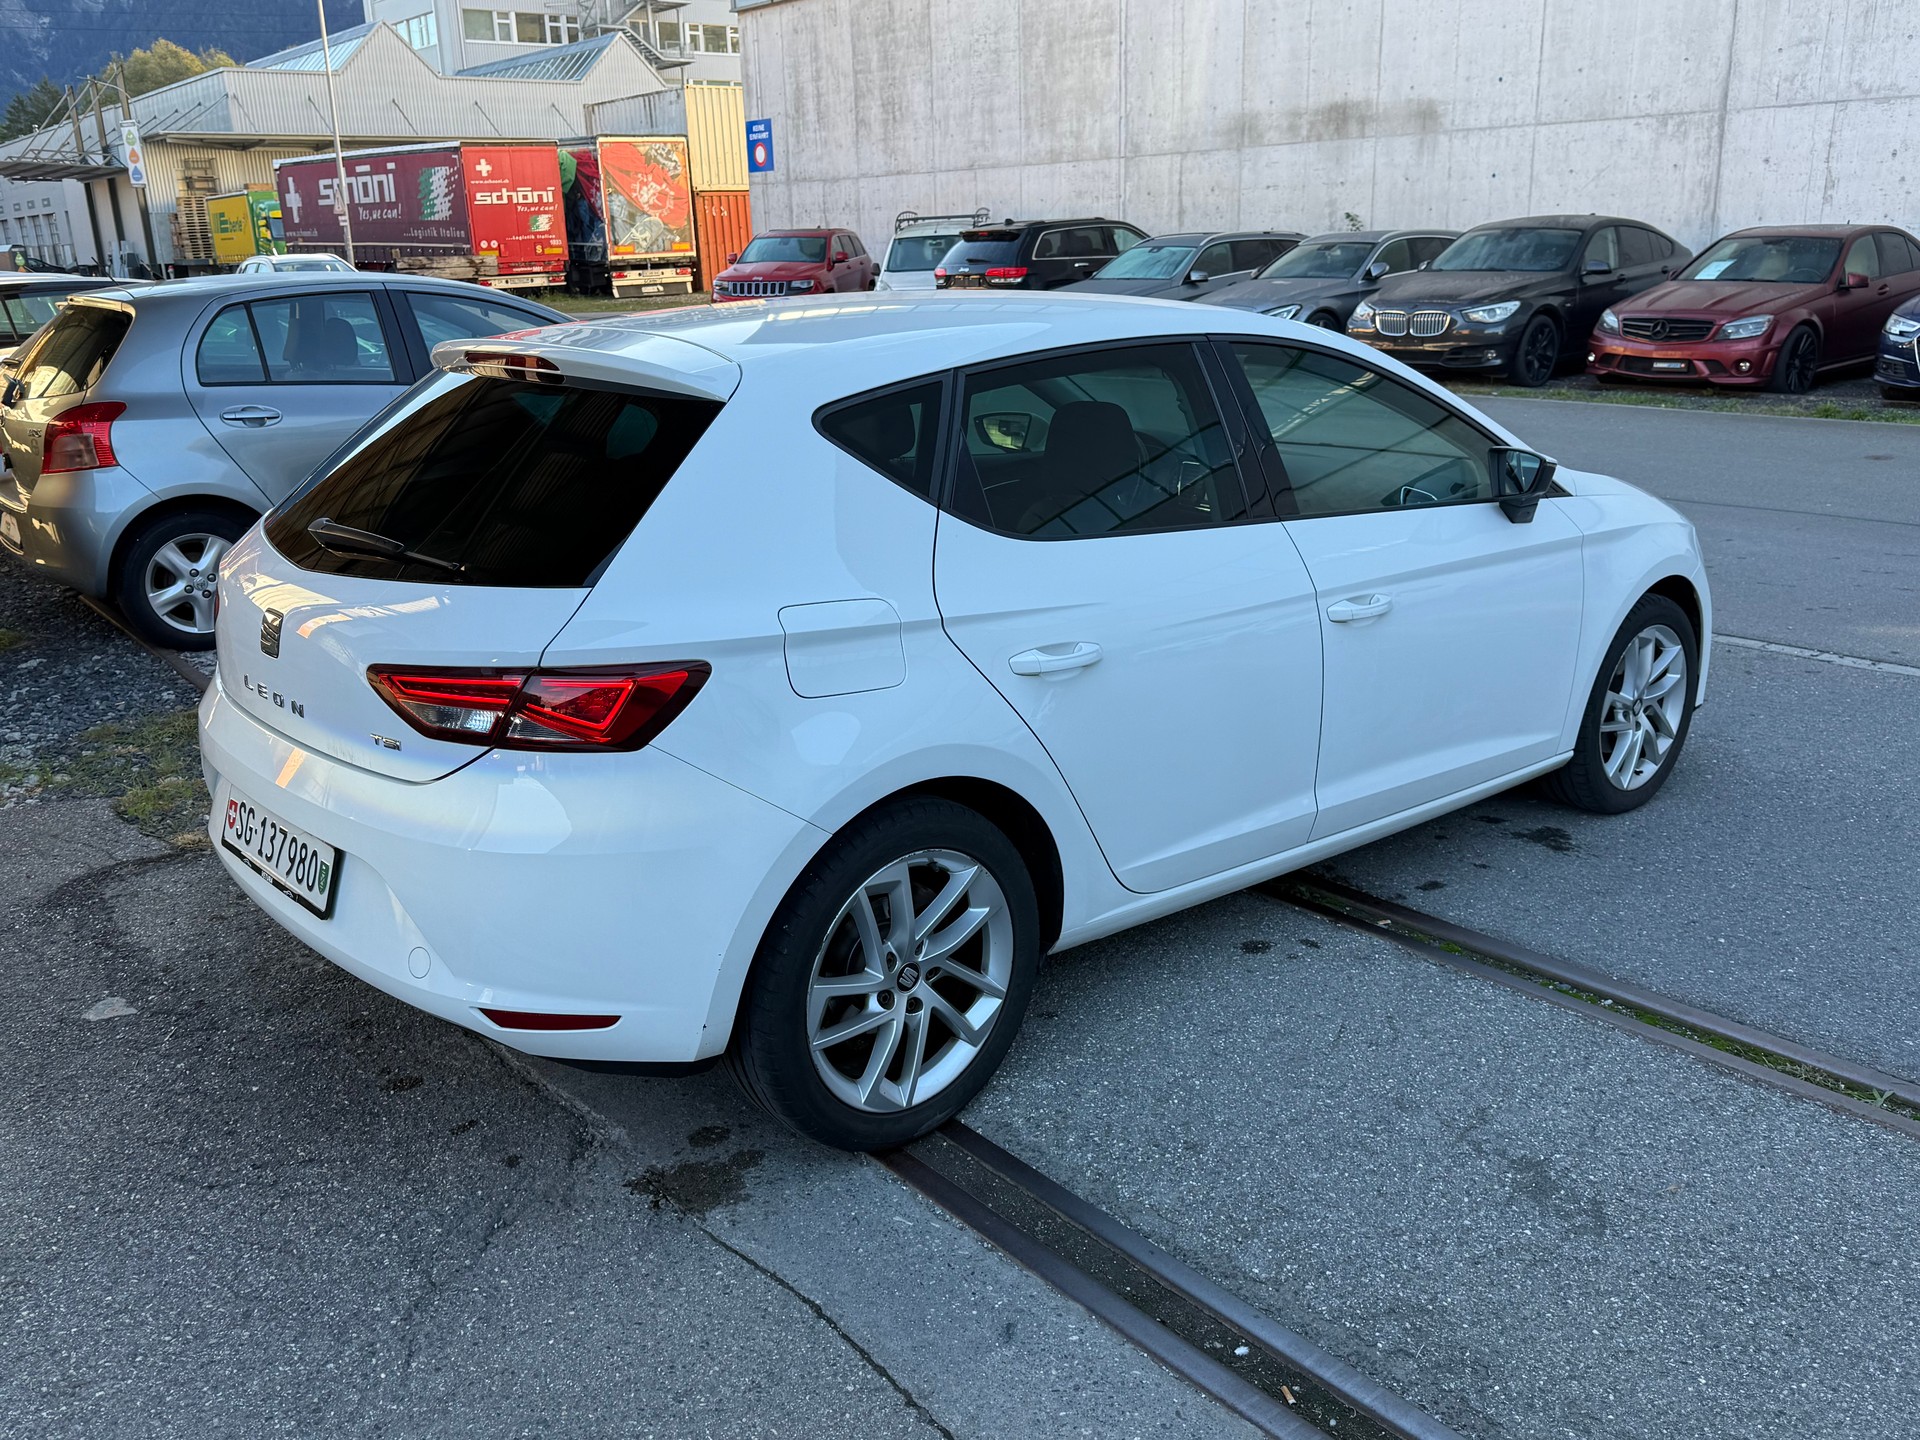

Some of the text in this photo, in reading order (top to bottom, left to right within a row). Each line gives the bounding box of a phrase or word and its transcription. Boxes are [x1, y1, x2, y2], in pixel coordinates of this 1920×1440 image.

[753, 124, 765, 132] KEINE
[749, 132, 769, 140] EINFAHRT
[474, 186, 556, 205] schöni
[439, 227, 466, 238] Italien
[244, 673, 305, 719] LEON
[370, 733, 402, 751] TSI
